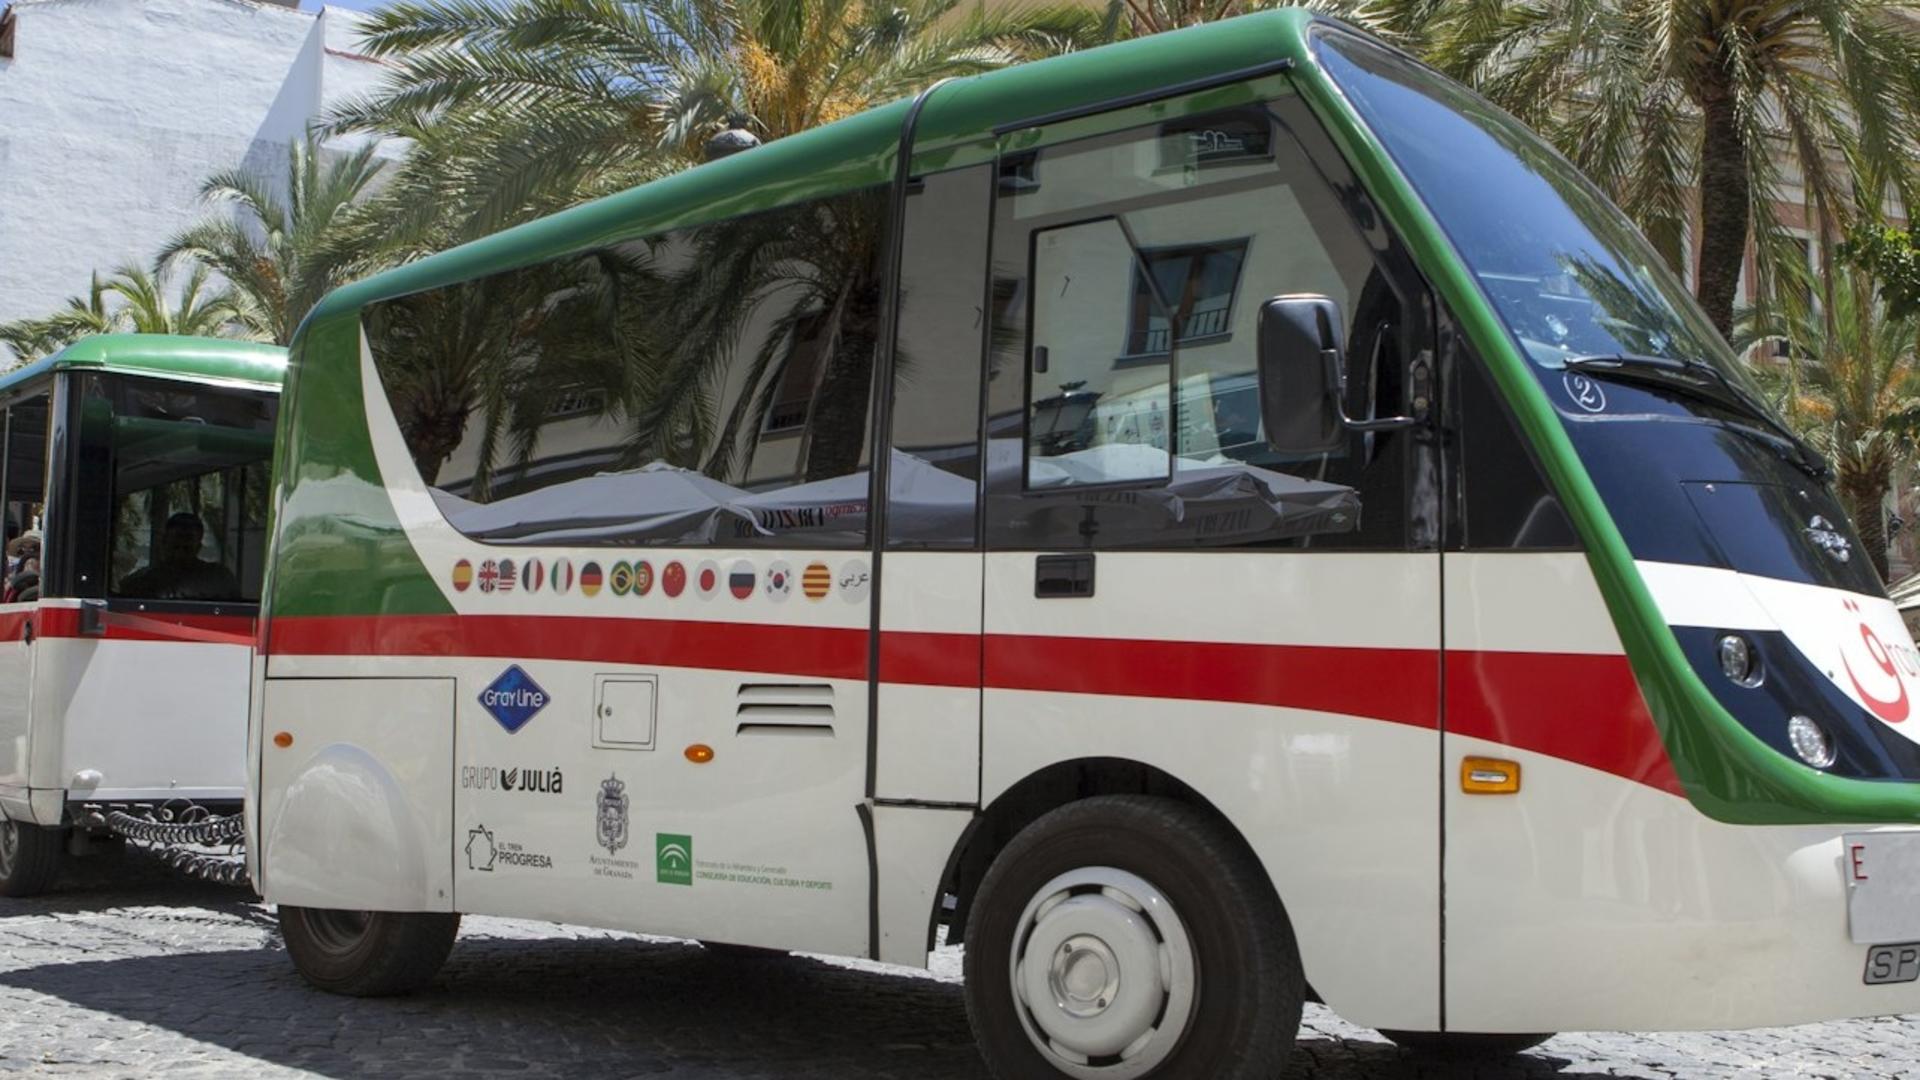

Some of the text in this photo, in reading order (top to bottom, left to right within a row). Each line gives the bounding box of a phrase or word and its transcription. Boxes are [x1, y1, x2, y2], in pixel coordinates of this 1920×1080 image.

[1574, 376, 1595, 403] 2
[839, 571, 869, 588] عربي
[462, 766, 498, 790] GRUPO
[498, 851, 553, 869] PROGRESA
[1851, 845, 1869, 880] E
[1872, 949, 1918, 980] SP
